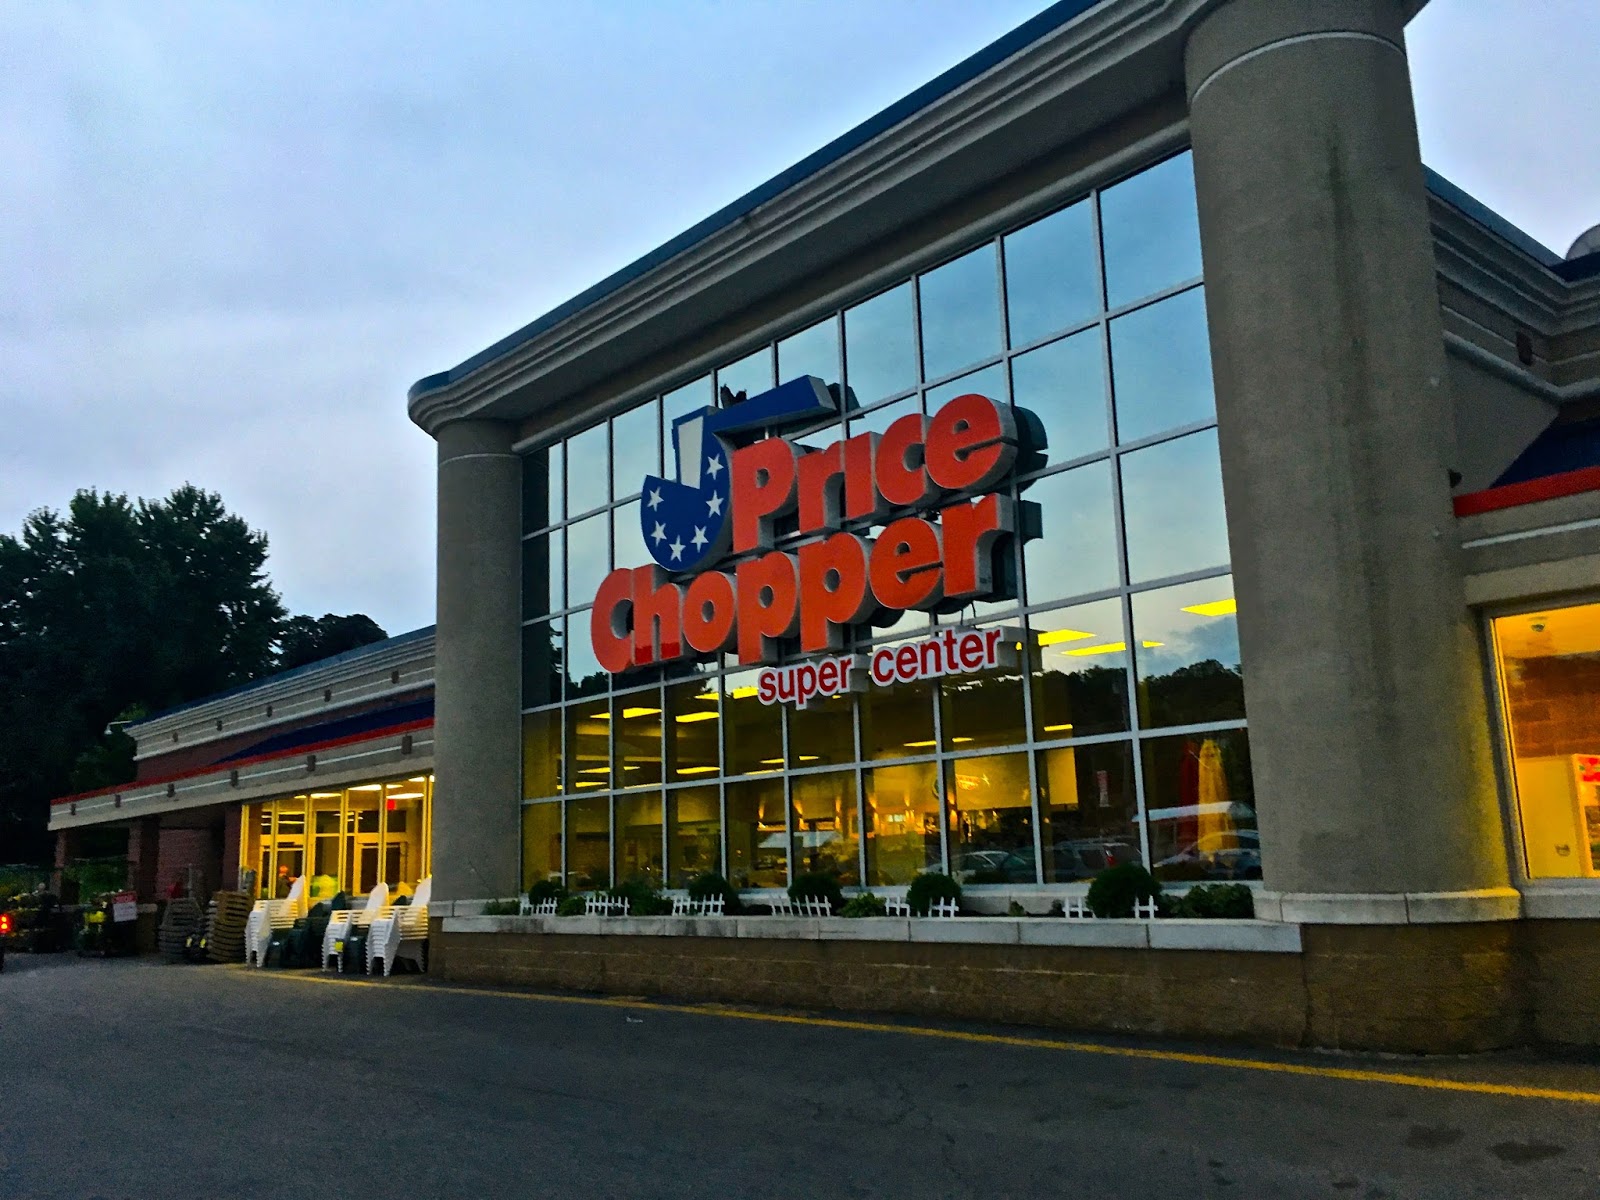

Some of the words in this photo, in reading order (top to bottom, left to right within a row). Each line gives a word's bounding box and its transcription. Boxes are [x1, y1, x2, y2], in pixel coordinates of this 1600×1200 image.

[731, 394, 1002, 553] Price
[591, 493, 999, 673] Chopper
[758, 657, 852, 705] super
[872, 628, 1002, 684] center
